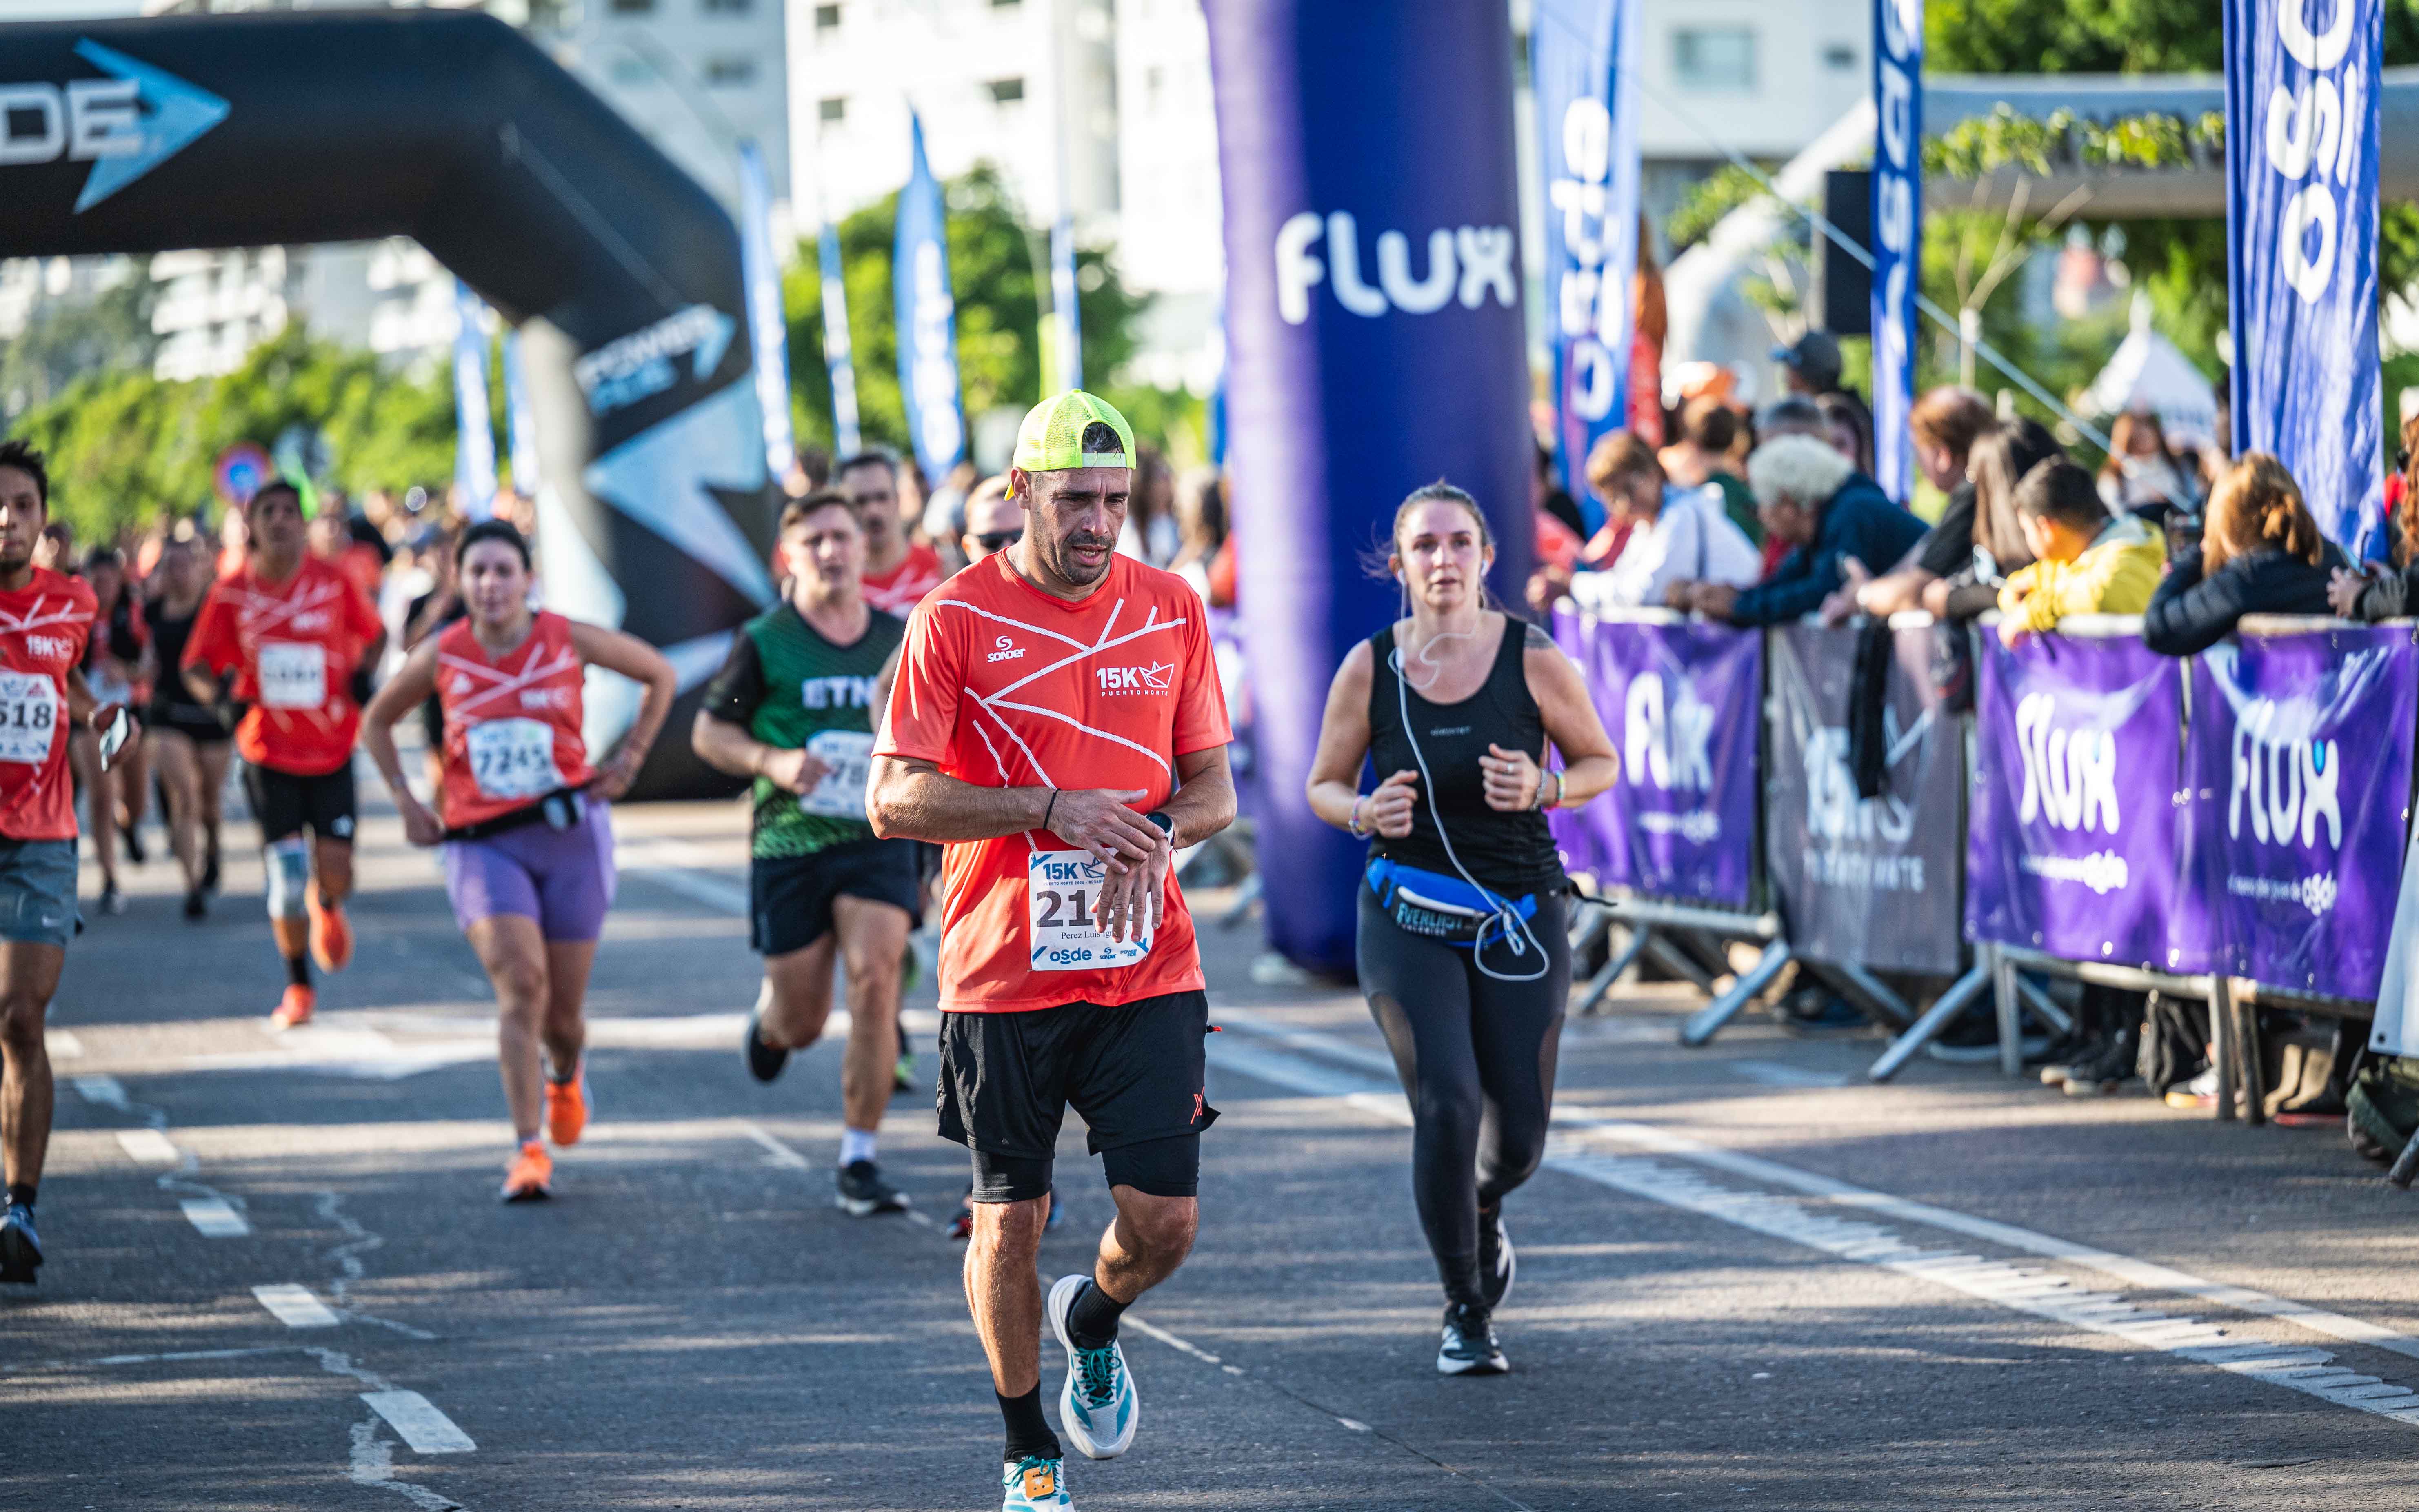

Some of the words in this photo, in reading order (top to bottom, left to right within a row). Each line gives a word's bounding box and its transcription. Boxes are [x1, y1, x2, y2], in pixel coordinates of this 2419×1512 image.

[1096, 667, 1140, 689] 15K
[1043, 862, 1079, 880] 15K
[1062, 931, 1082, 939] Perez
[1084, 930, 1100, 938] Luis
[1050, 947, 1092, 964] osde
